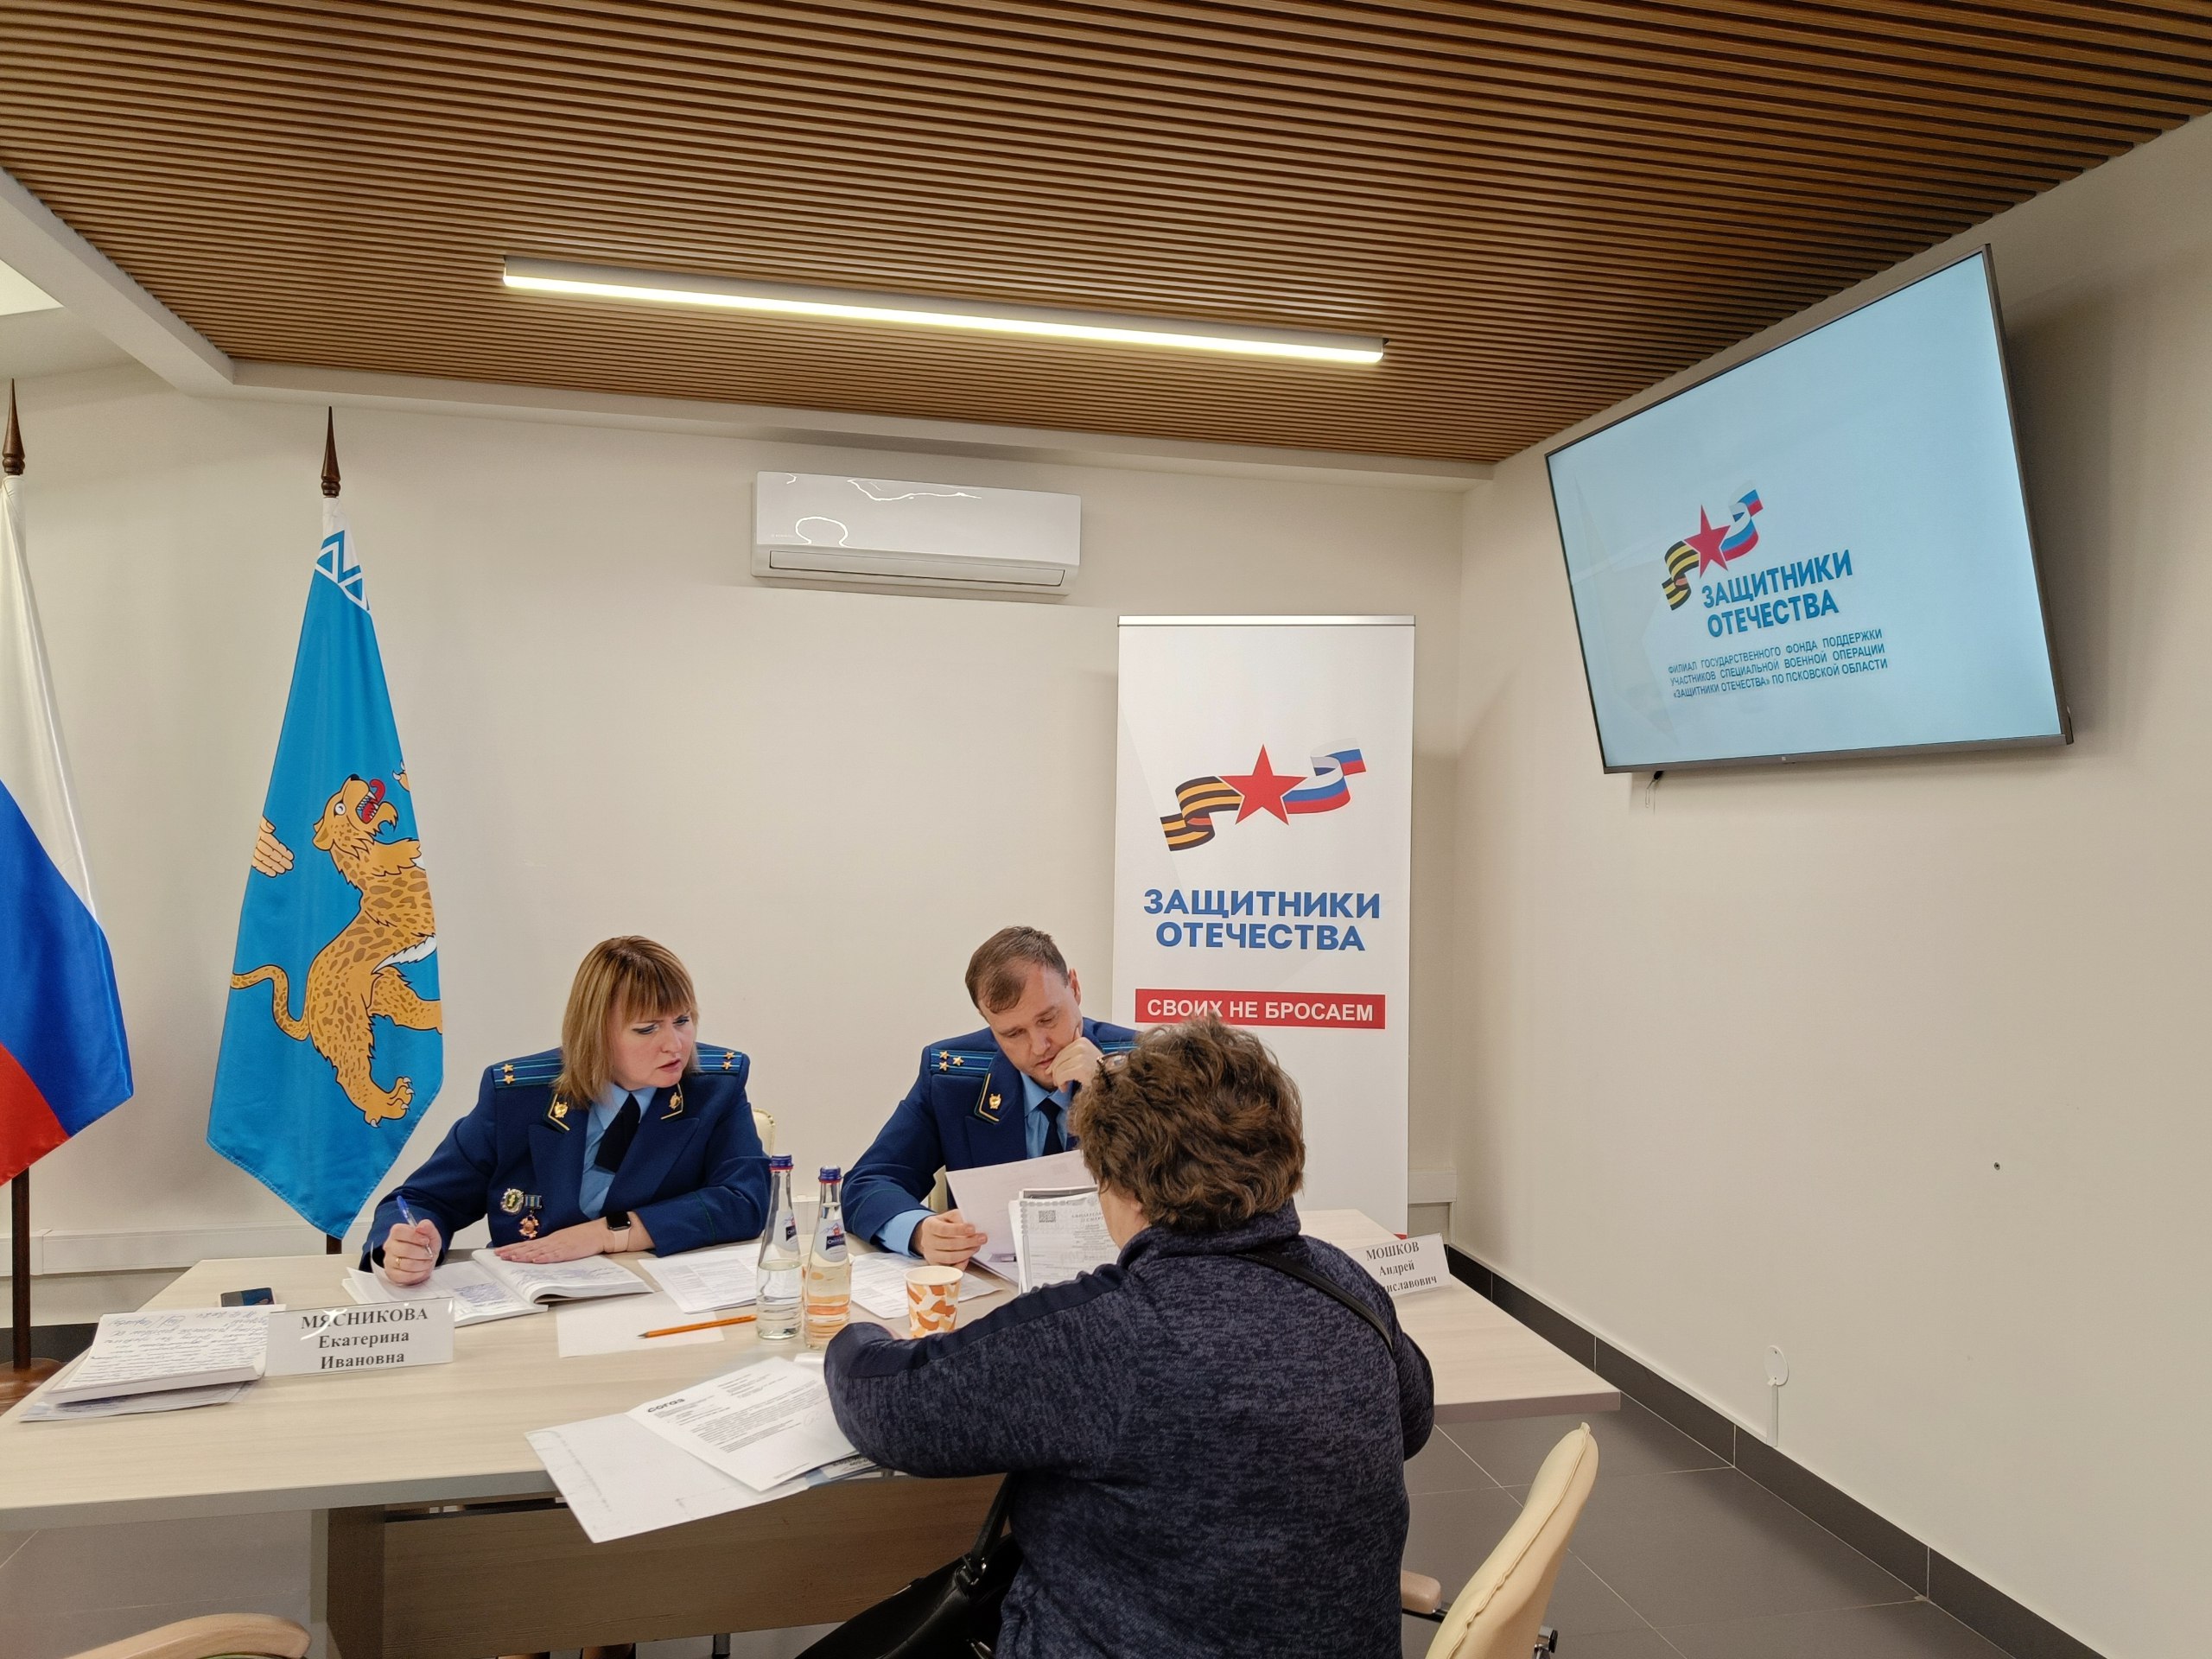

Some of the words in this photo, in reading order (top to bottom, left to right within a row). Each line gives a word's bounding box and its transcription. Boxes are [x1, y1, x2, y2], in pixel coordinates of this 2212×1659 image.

[1701, 549, 1853, 608] ЗАЩИТНИКИ
[1707, 589, 1840, 638] ОТЕЧЕСТВА
[1668, 662, 1697, 674] ФИЛИАЛ
[1700, 646, 1781, 669] ГОСУДАРСТВЕННОГО
[1785, 641, 1818, 654] ФОНДА
[1822, 629, 1883, 648] ПОДДЕРЖКИ
[1670, 672, 1717, 687] УЧАСТНИКОВ
[1719, 660, 1780, 679] СПЕЦИАЛЬНОЙ
[1784, 650, 1827, 669] ВОЕННОЙ
[1833, 644, 1885, 661] ОПЕРАЦИИ
[1673, 683, 1719, 698] «ЗАЩИТНИКИ
[1721, 675, 1770, 692] ОТЕЧЕСТВА»
[1772, 674, 1784, 685] ПО
[1786, 664, 1840, 683] ПСКОВСКОЙ
[1841, 658, 1888, 675] ОБЛАСТИ
[1143, 889, 1381, 918] ЗАЩИТНИКИ
[1156, 922, 1365, 950] ОТЕЧЕСТВА
[1147, 999, 1223, 1018] СВОИХ
[1230, 1001, 1258, 1019] НЕ
[1265, 1002, 1373, 1021] БРОСАЕМ
[1366, 1241, 1420, 1262] МОШКОВ
[1379, 1260, 1415, 1277] Андрей
[1384, 1275, 1437, 1293] иславович
[301, 1307, 429, 1329] МЯСНИКОВА
[319, 1332, 410, 1349] Екатерина
[321, 1353, 404, 1370] Ивановна
